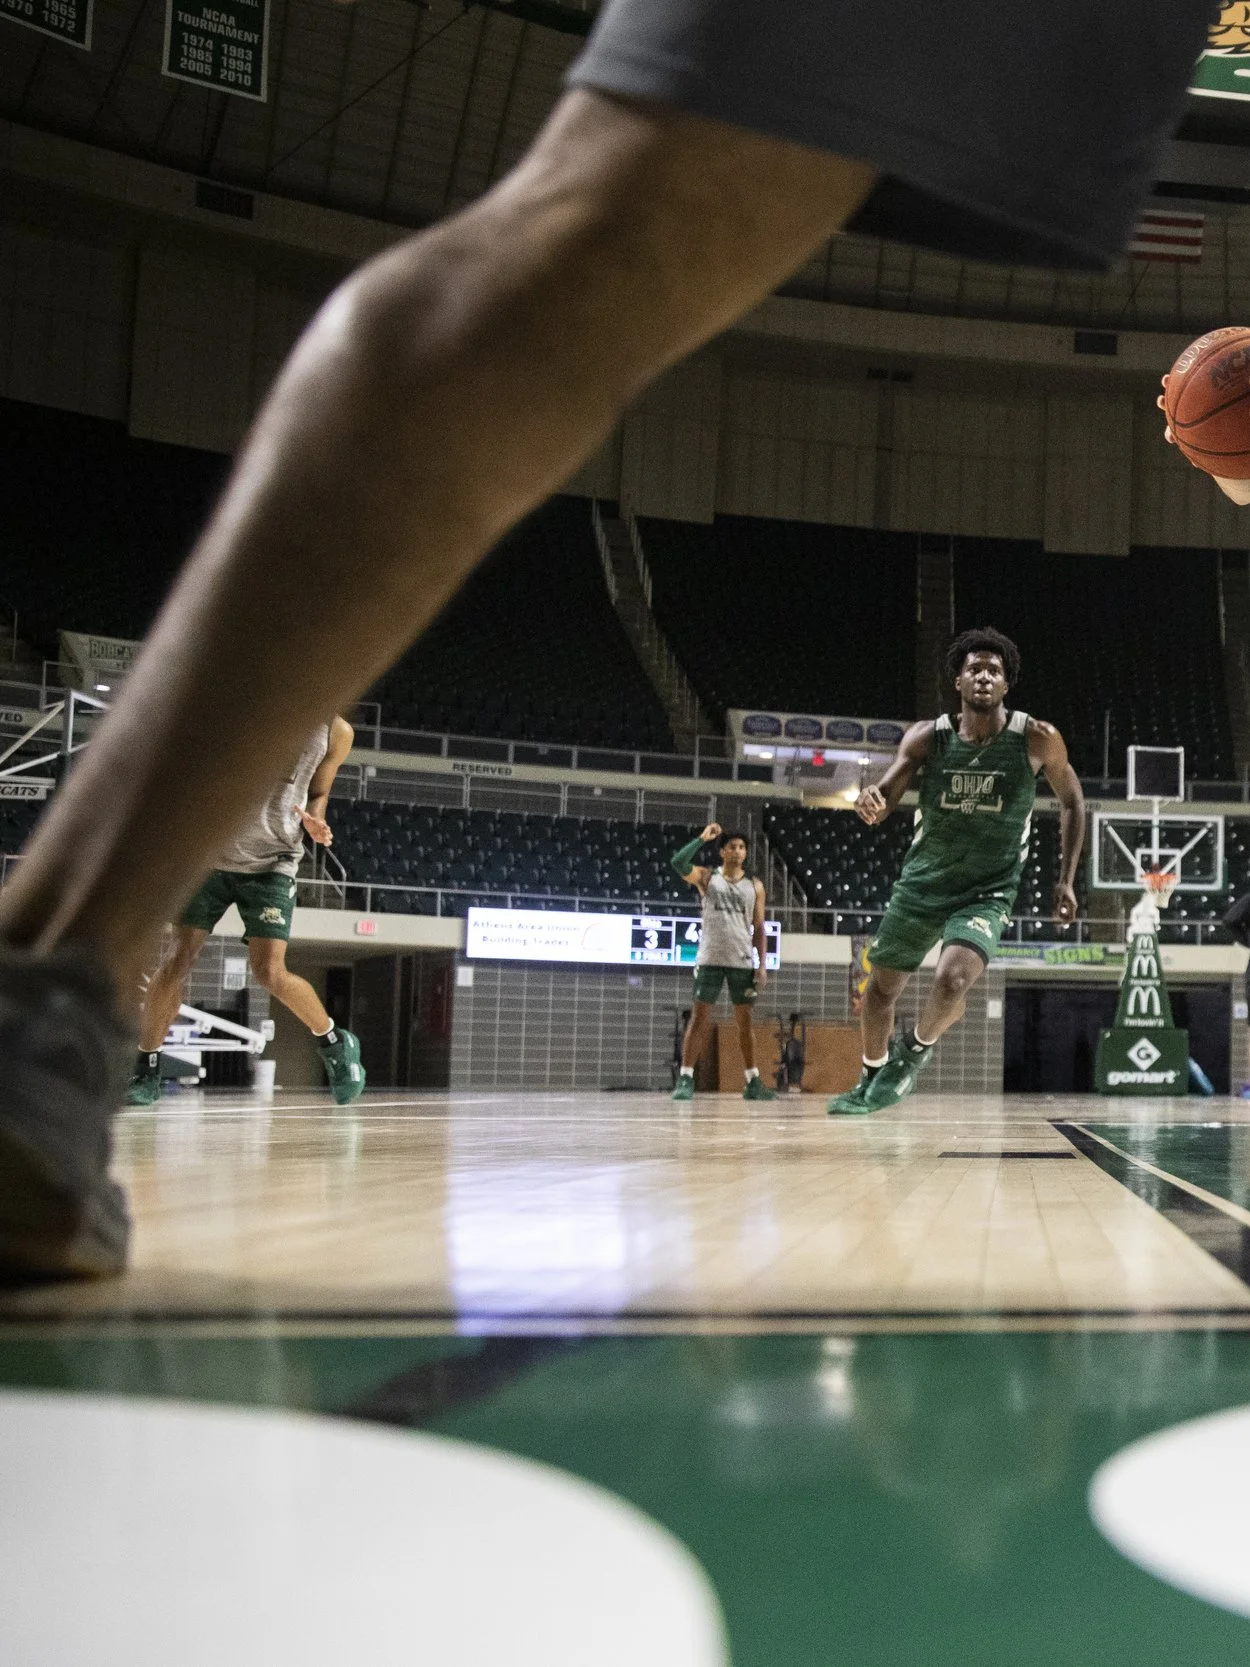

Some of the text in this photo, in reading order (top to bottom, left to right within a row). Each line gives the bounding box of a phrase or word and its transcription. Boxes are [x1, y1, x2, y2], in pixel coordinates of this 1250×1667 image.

[42, 10, 76, 33] 1972
[177, 10, 260, 44] TOURNAMENT
[202, 7, 236, 27] NCAA
[181, 31, 253, 62] 1974 1983
[180, 44, 252, 74] 1985 1994
[179, 57, 252, 87] 2005 2010
[452, 763, 513, 776] RESERVED
[951, 774, 995, 794] OHIO
[645, 930, 658, 950] 3
[1043, 943, 1104, 965] SIGNS
